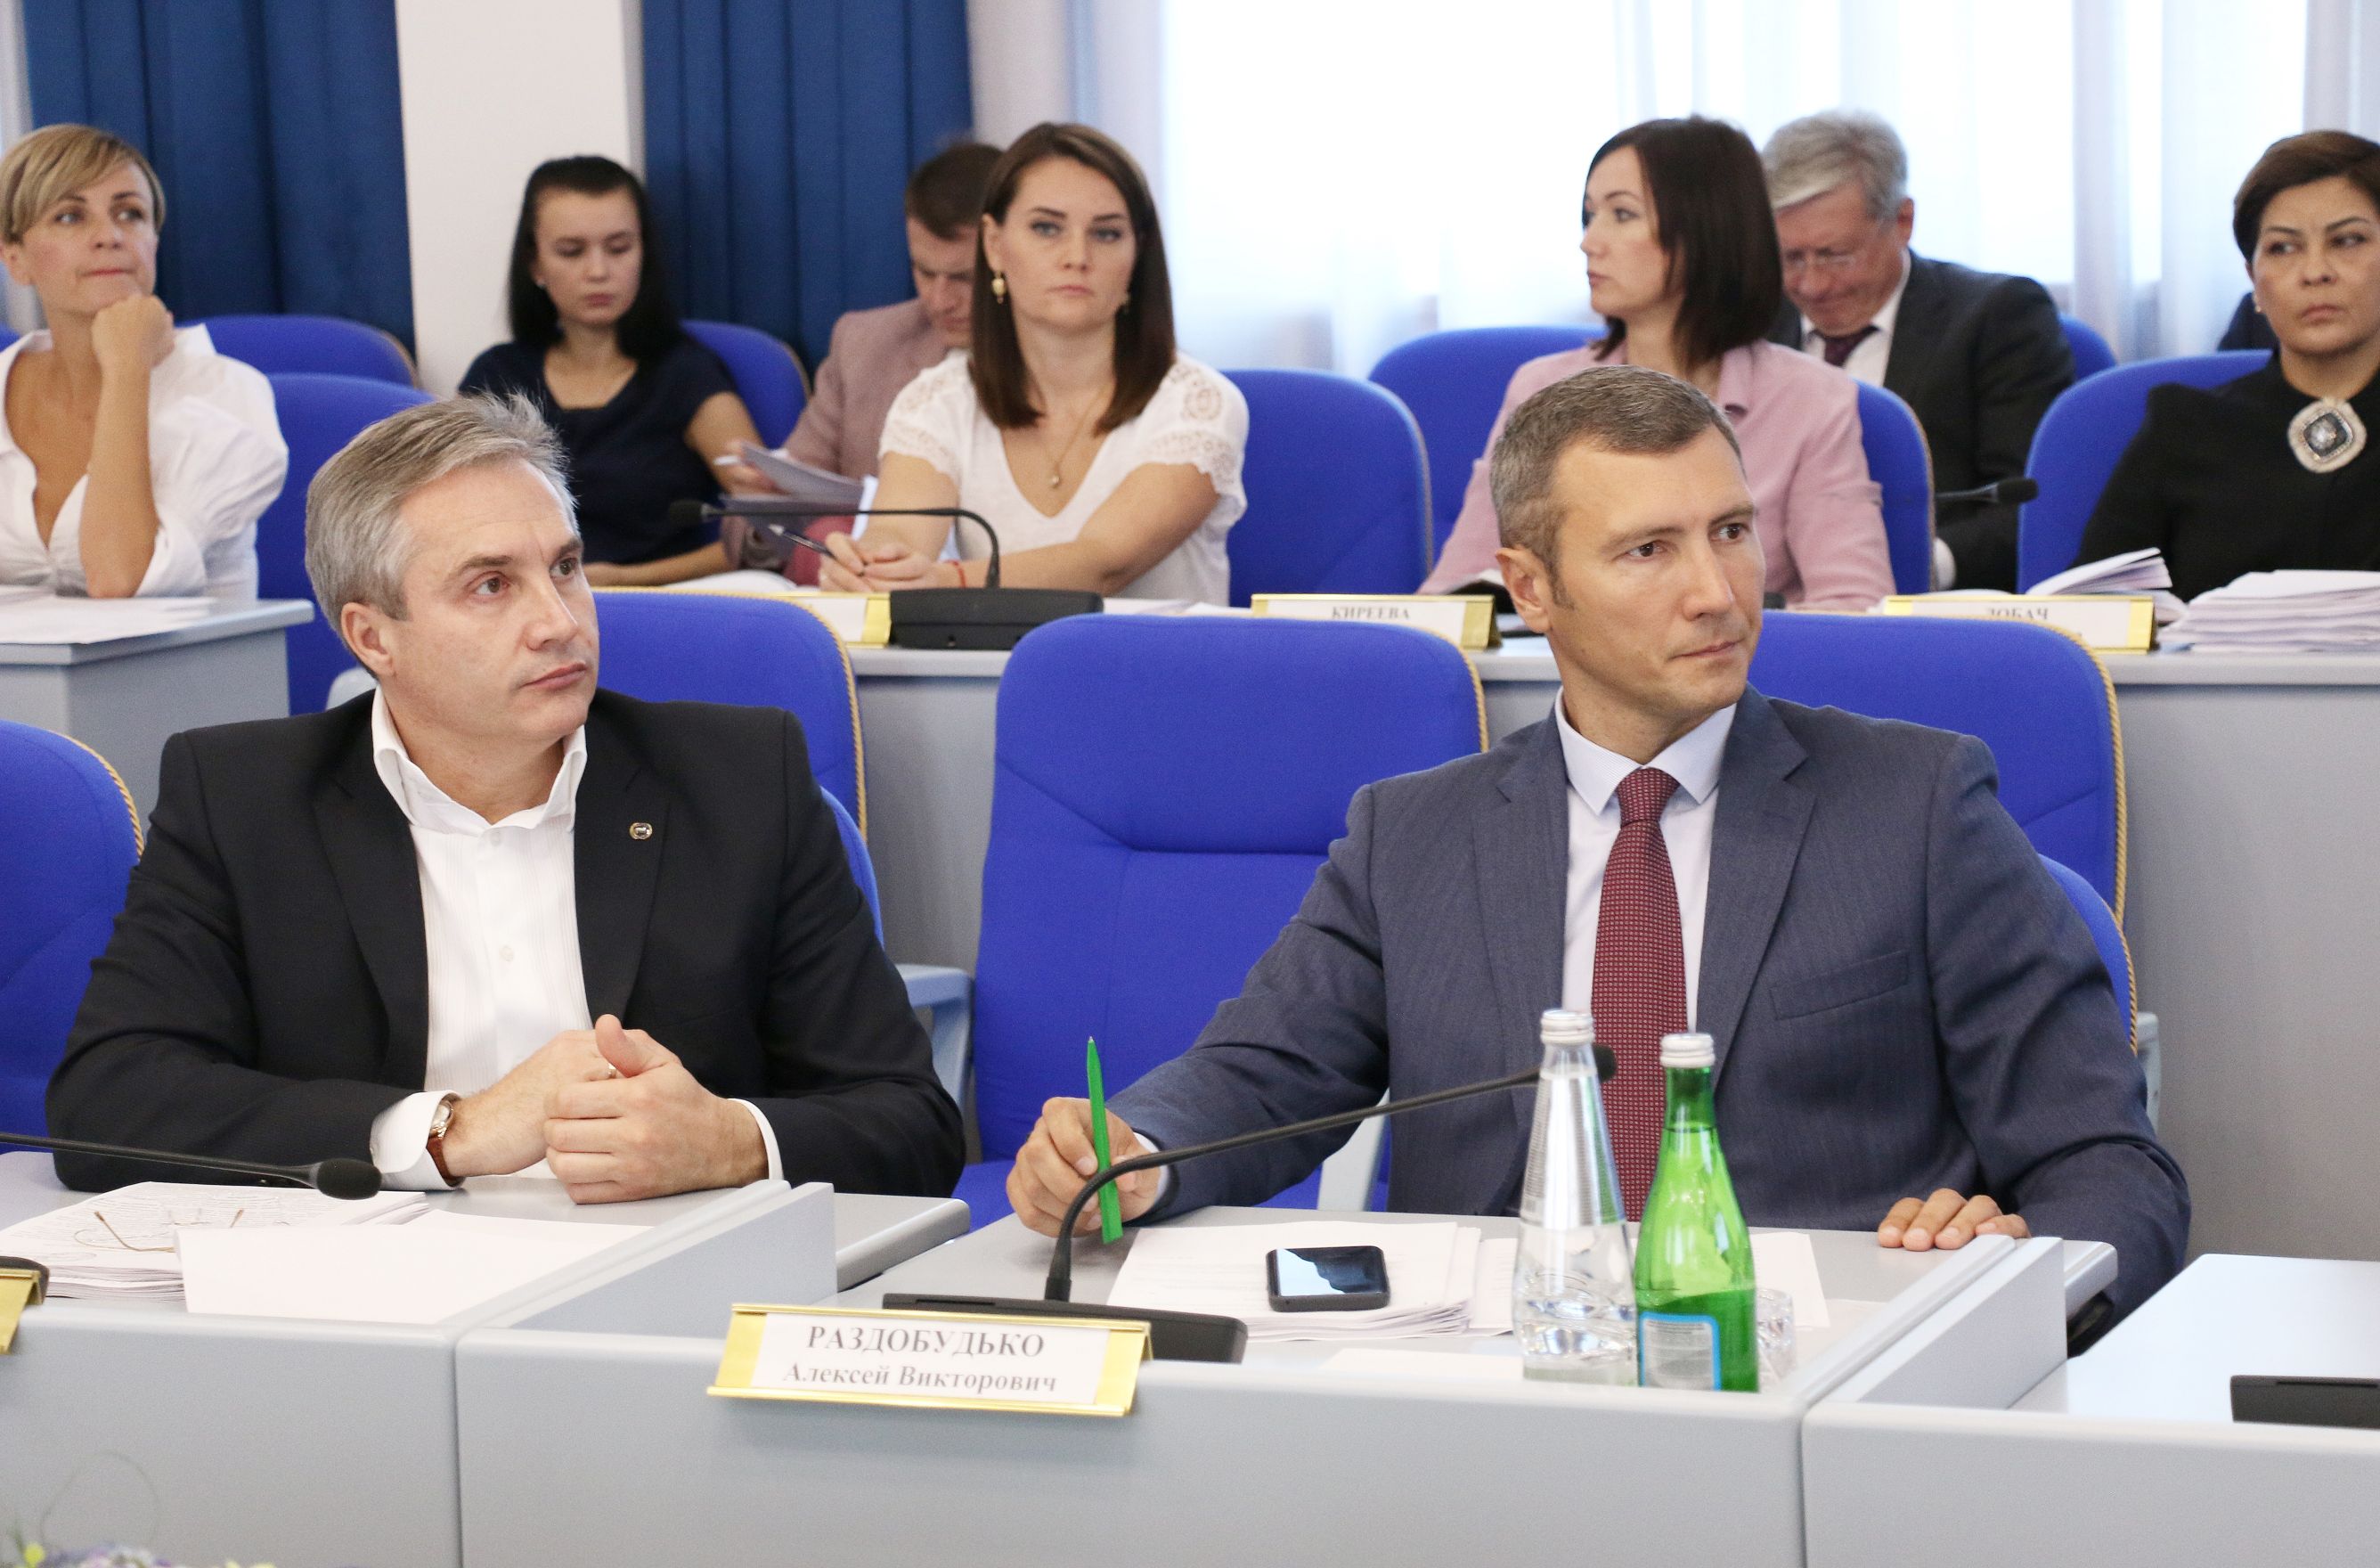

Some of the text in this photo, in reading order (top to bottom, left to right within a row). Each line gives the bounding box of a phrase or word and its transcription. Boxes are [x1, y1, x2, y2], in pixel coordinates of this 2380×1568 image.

[1333, 606, 1410, 620] КИРЕЕВА
[807, 1326, 1045, 1357] РАЗДОБУДЬКО
[782, 1363, 1057, 1393] Алексей Викторович
